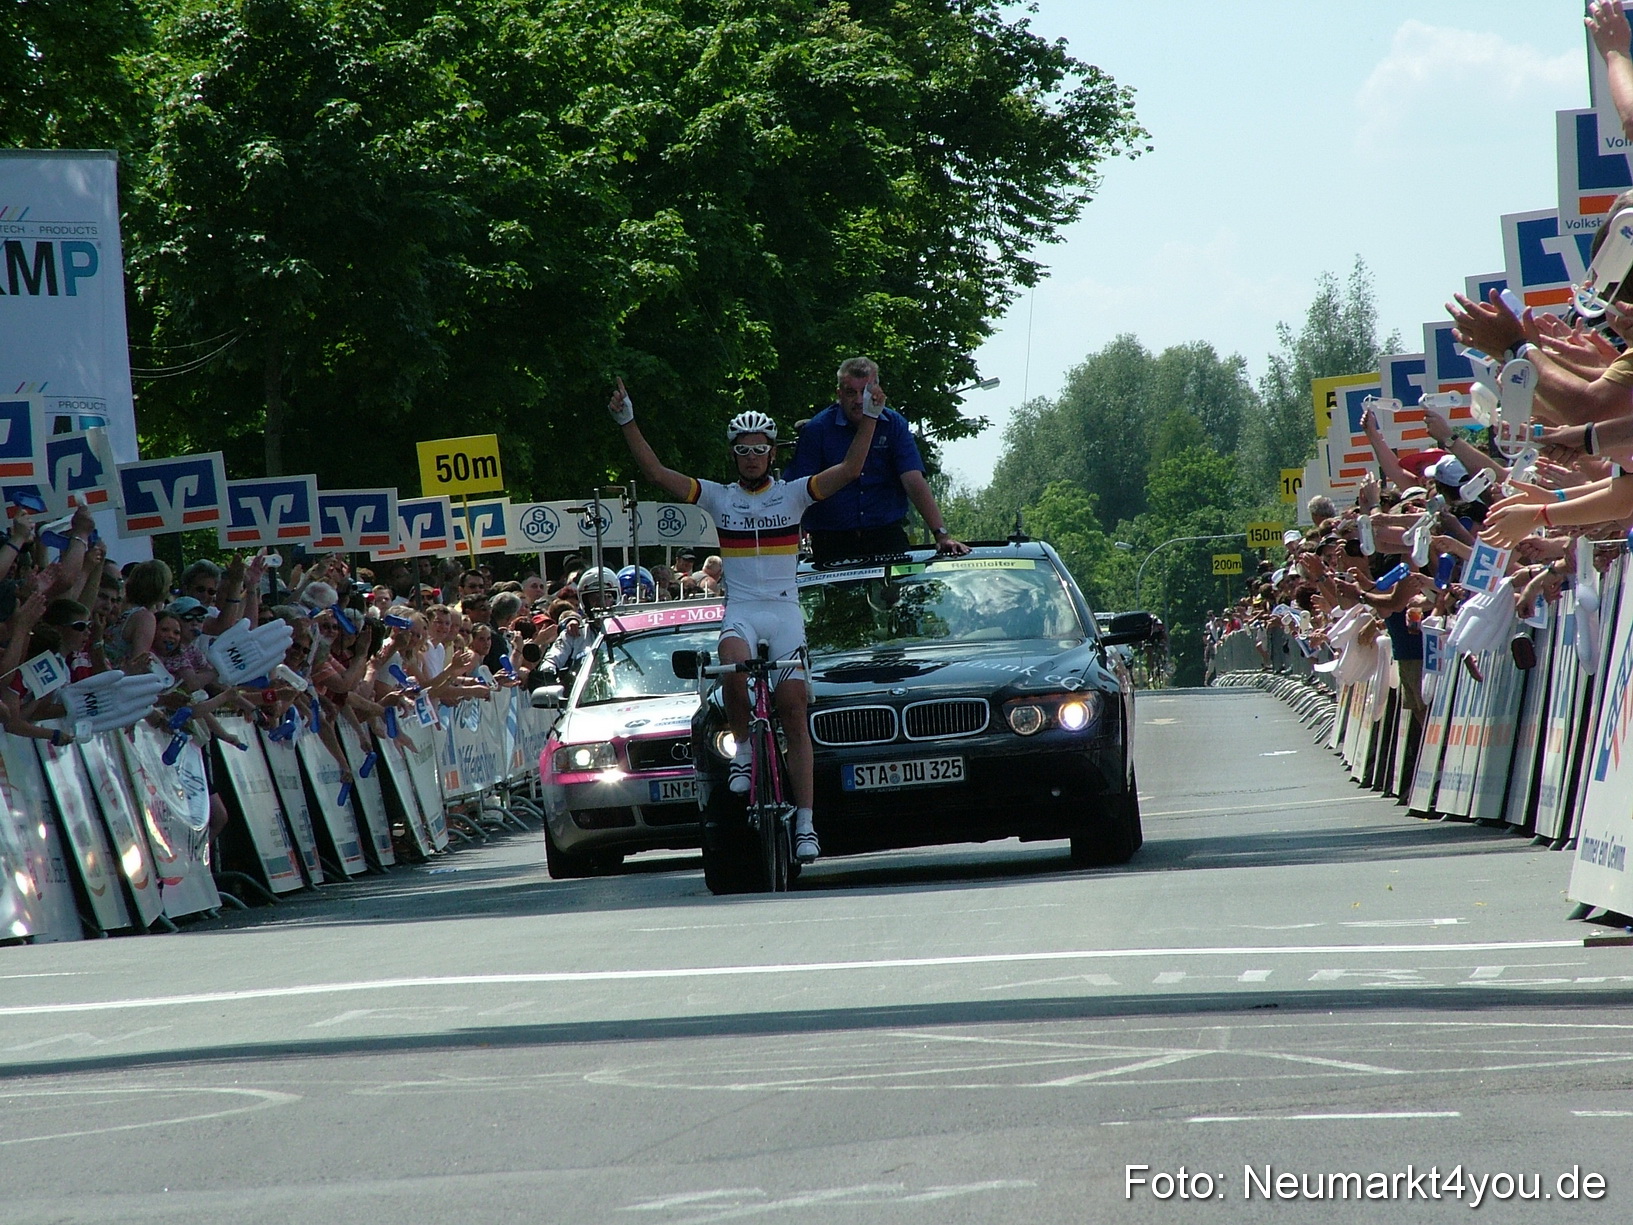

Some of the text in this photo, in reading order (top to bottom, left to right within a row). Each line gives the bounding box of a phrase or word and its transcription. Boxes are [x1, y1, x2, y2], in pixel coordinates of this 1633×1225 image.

[39, 225, 98, 235] PRODUCTS
[0, 241, 98, 296] MP
[435, 452, 498, 483] 50m
[1249, 528, 1282, 542] 150m
[1214, 559, 1241, 570] 200m
[226, 646, 246, 671] KMP
[83, 691, 99, 717] KMP
[855, 759, 962, 786] STA DU 325
[662, 782, 681, 798] IN
